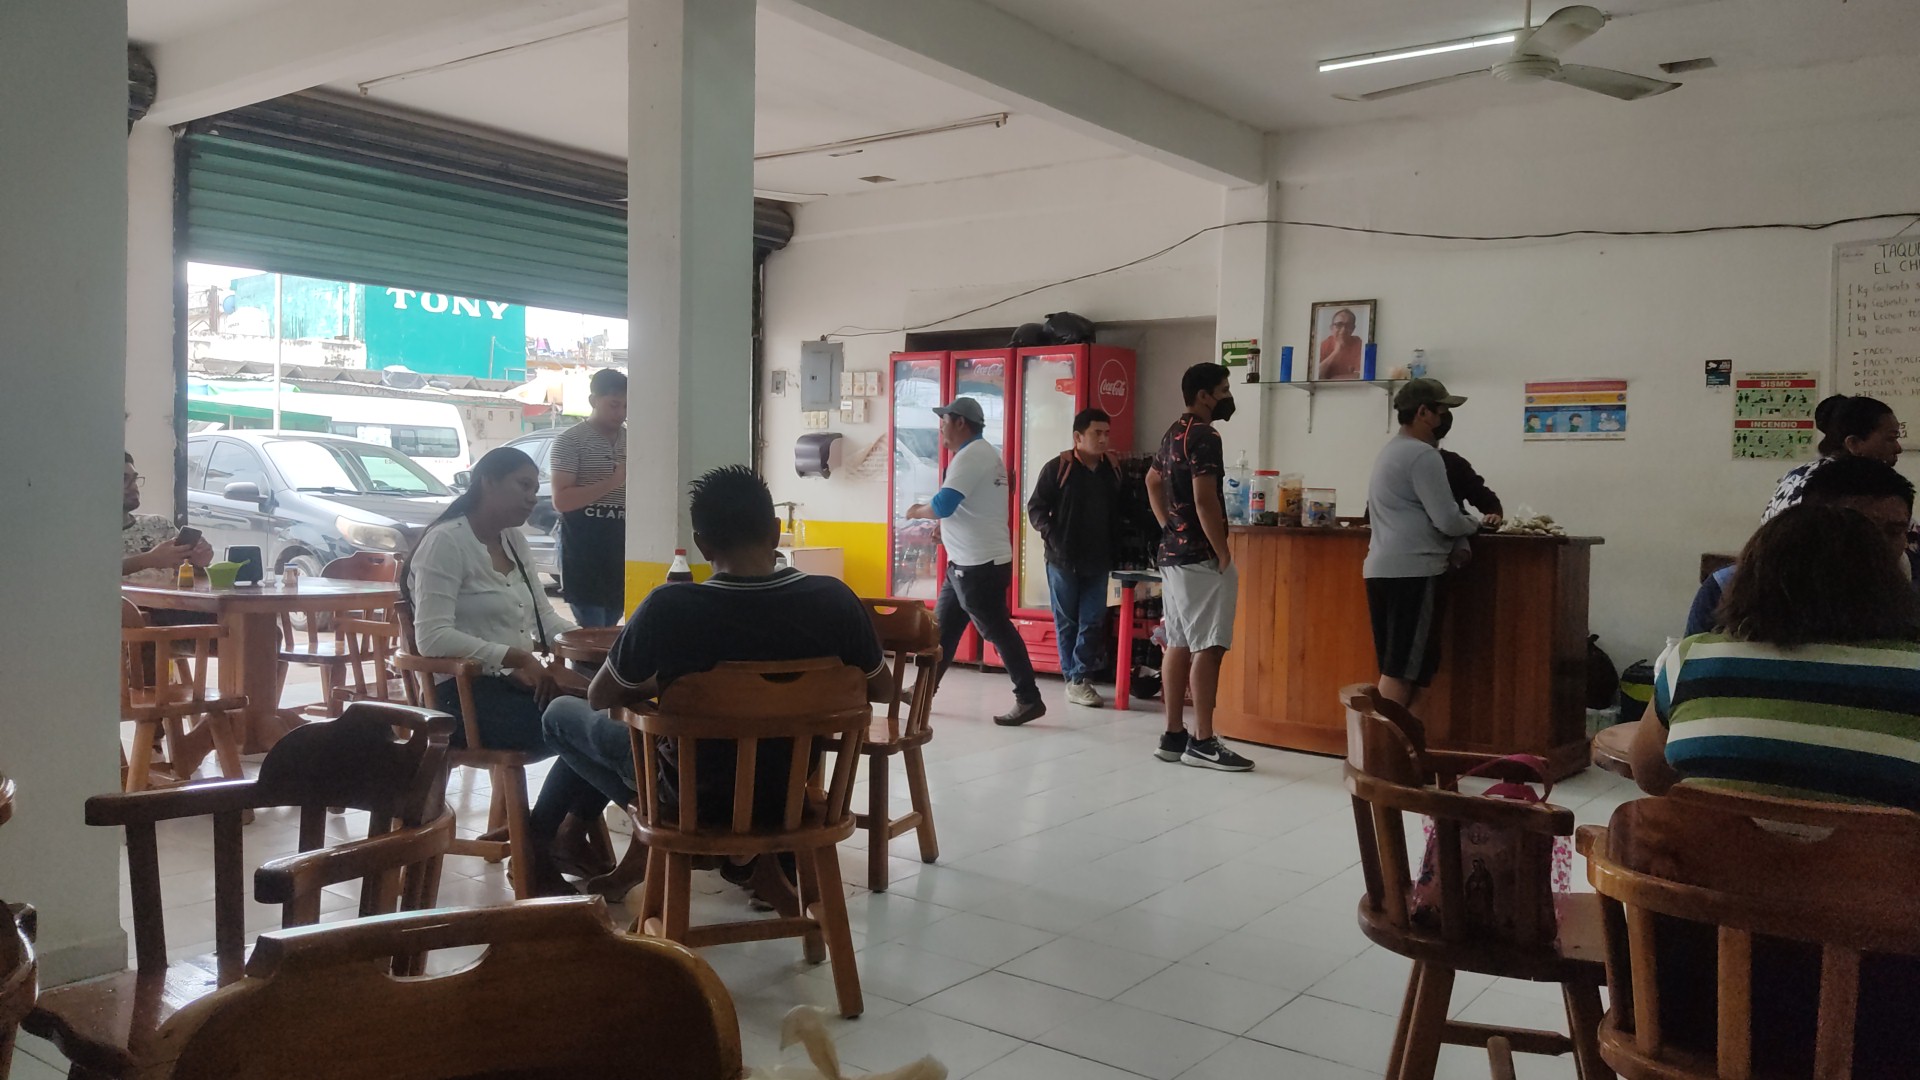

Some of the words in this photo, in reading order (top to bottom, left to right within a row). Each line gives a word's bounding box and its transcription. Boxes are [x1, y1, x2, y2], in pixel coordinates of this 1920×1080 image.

[1874, 261, 1891, 275] EL
[386, 287, 510, 320] TONY
[1100, 378, 1126, 397] Coca-Cola
[1760, 380, 1792, 388] SISMO
